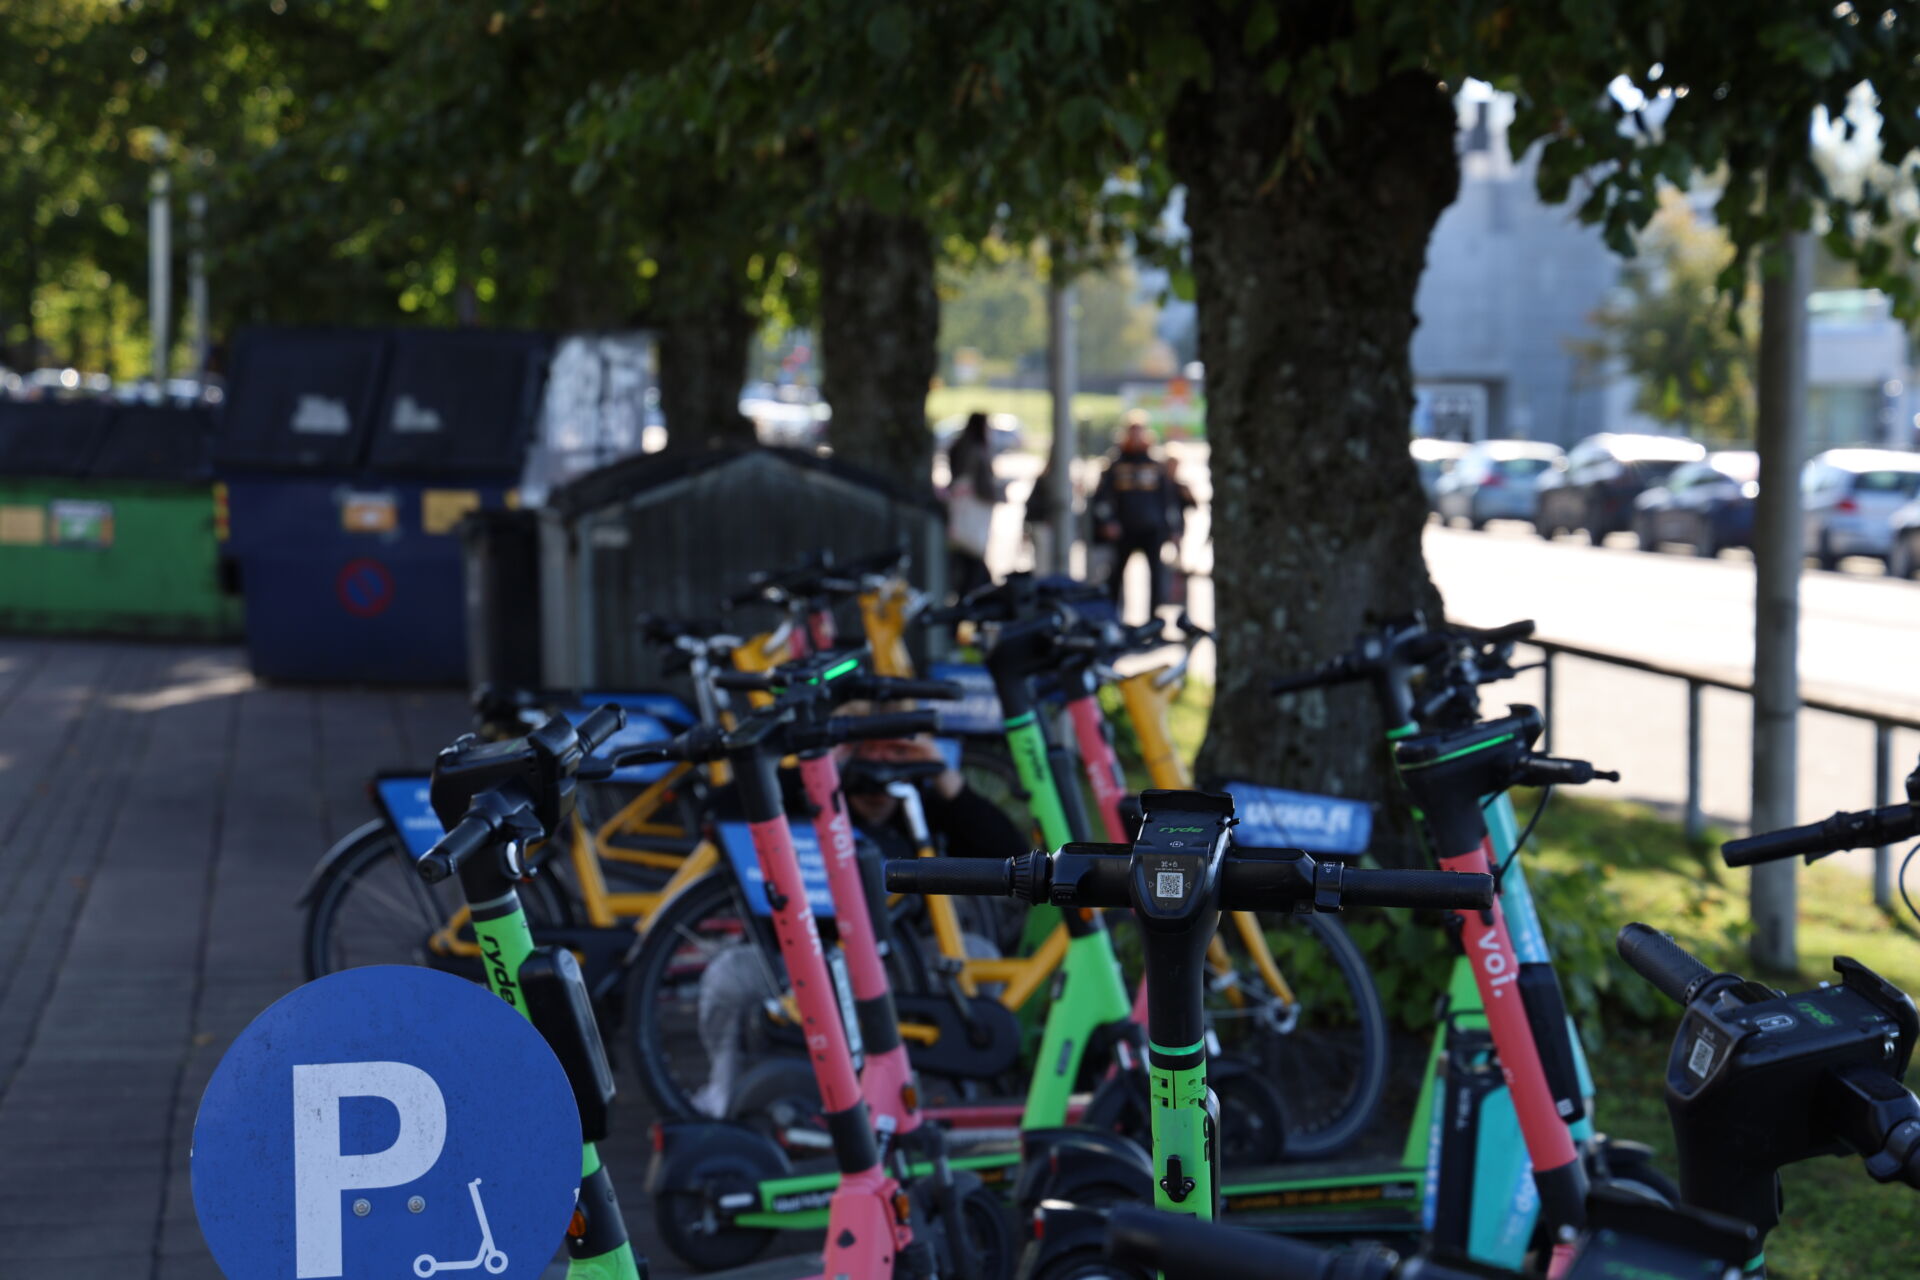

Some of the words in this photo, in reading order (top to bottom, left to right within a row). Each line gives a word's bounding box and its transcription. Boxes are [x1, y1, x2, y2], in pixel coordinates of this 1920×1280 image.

[1158, 826, 1205, 834] ryde
[482, 934, 516, 1007] ryde
[1477, 929, 1518, 998] voi.
[292, 1060, 447, 1279] P
